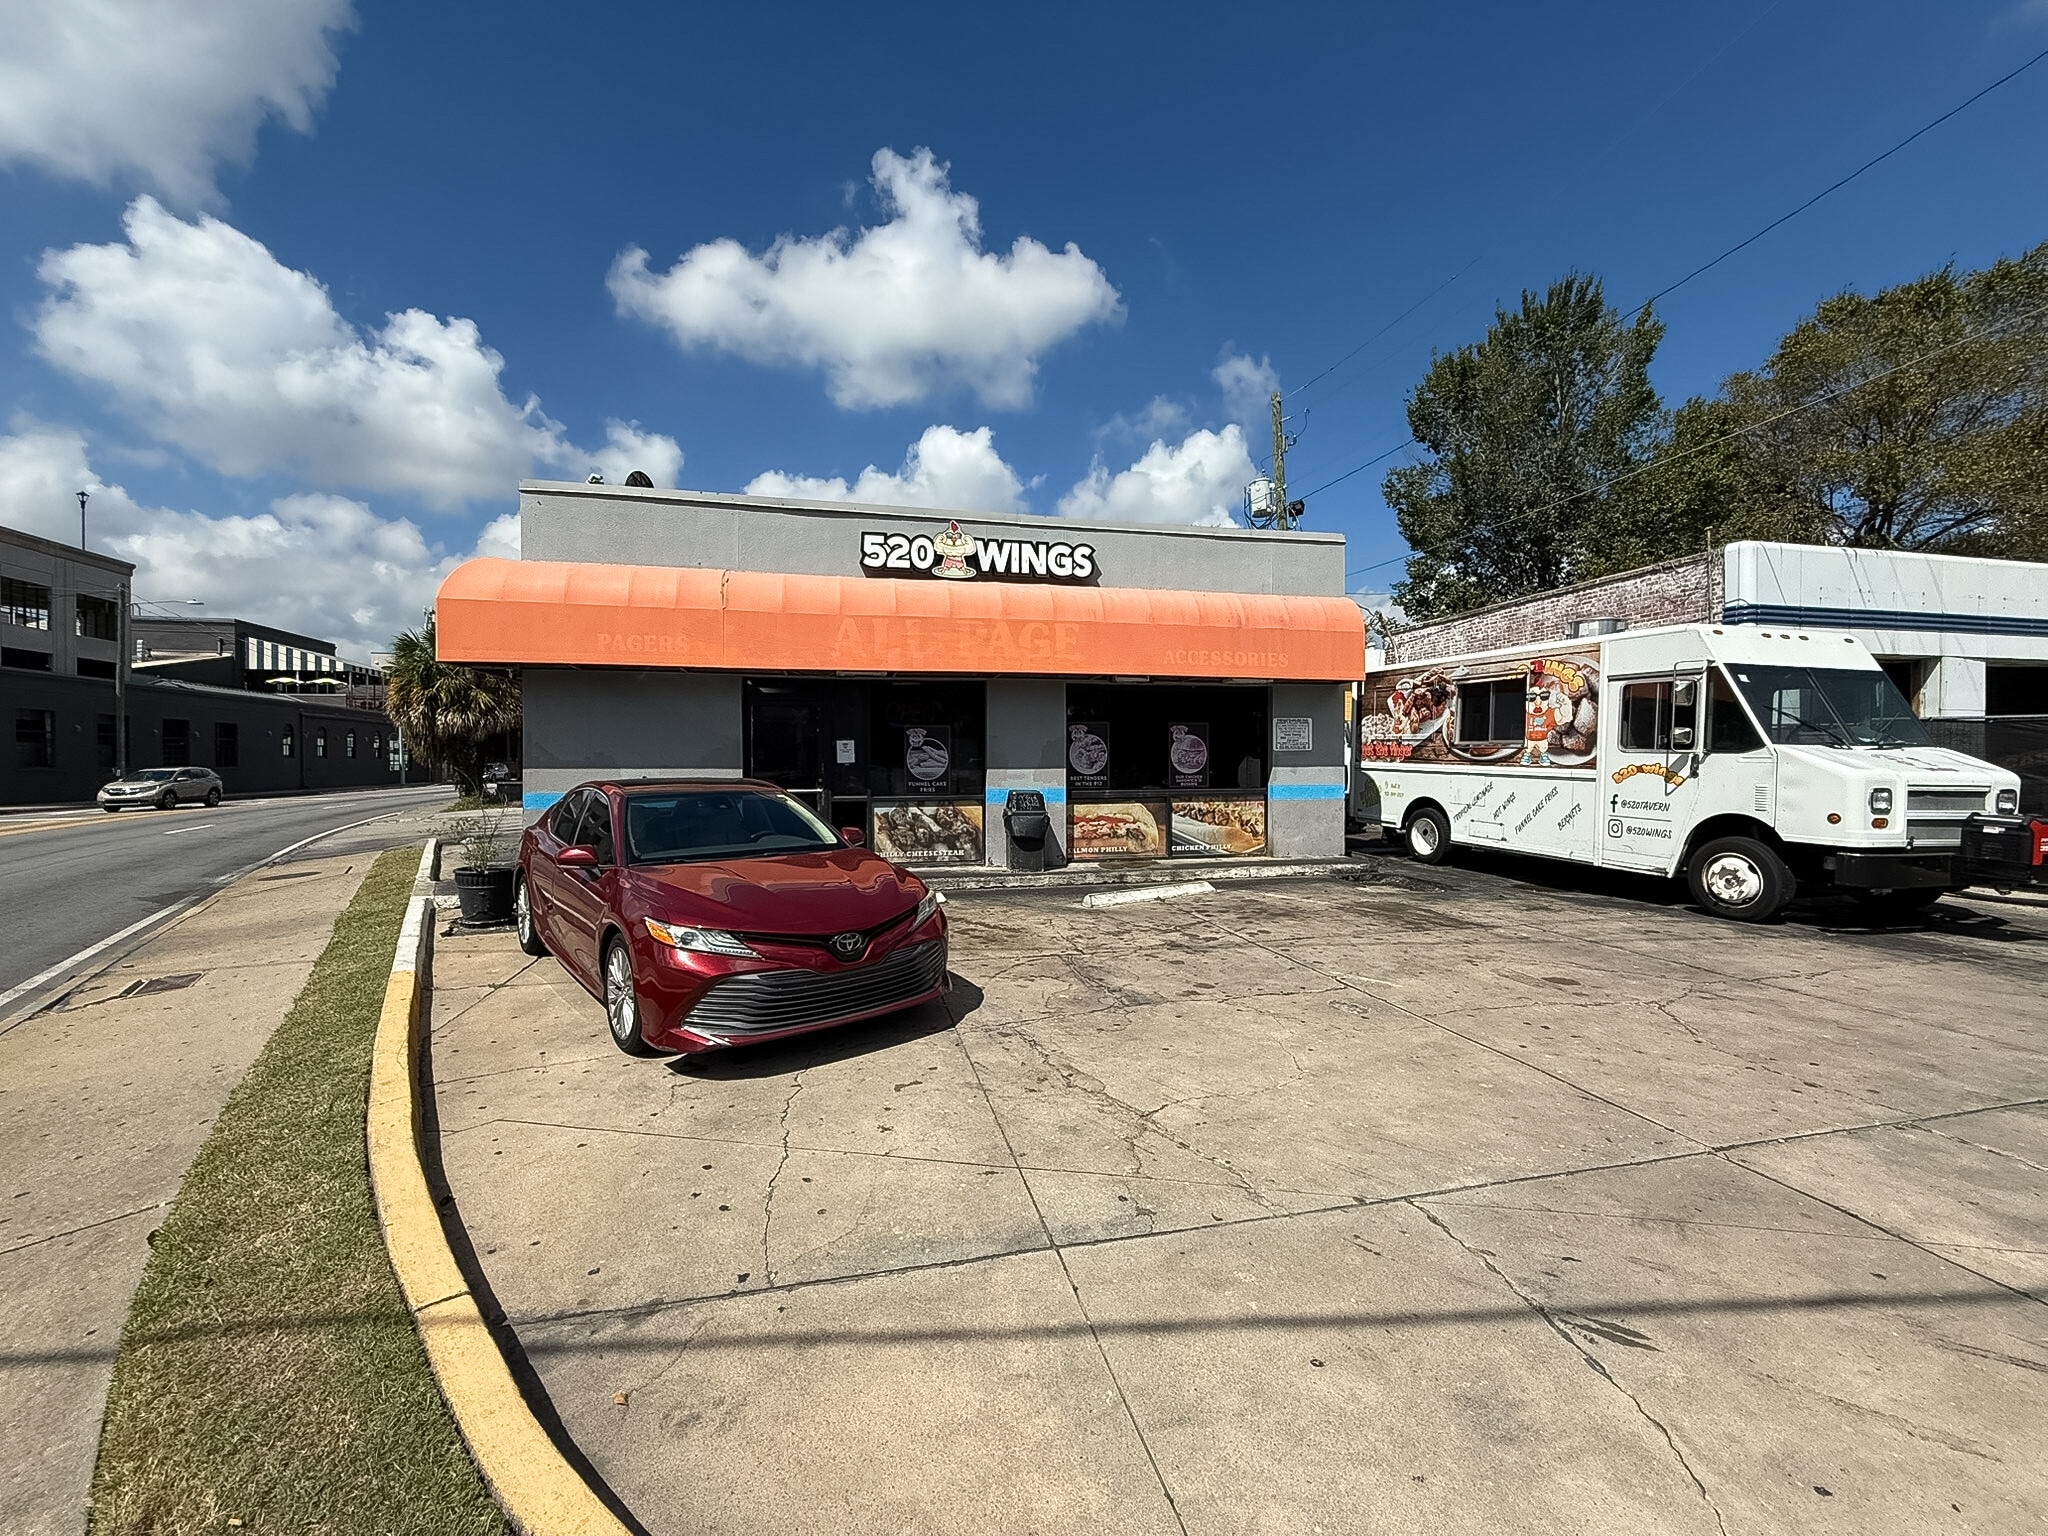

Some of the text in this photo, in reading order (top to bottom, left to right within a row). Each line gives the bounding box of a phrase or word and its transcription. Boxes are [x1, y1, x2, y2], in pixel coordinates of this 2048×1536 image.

[862, 533, 1094, 578] 520 WINGS
[597, 632, 689, 655] PAGERS
[957, 618, 1081, 663] PAGE
[1163, 650, 1289, 667] ACCESSORIES
[1541, 660, 1585, 692] INGS
[1544, 786, 1560, 805] FRIES
[1620, 799, 1671, 813] @520TAVERN
[1625, 825, 1673, 840] @520WINGS
[906, 849, 965, 858] CHEESESTEAK
